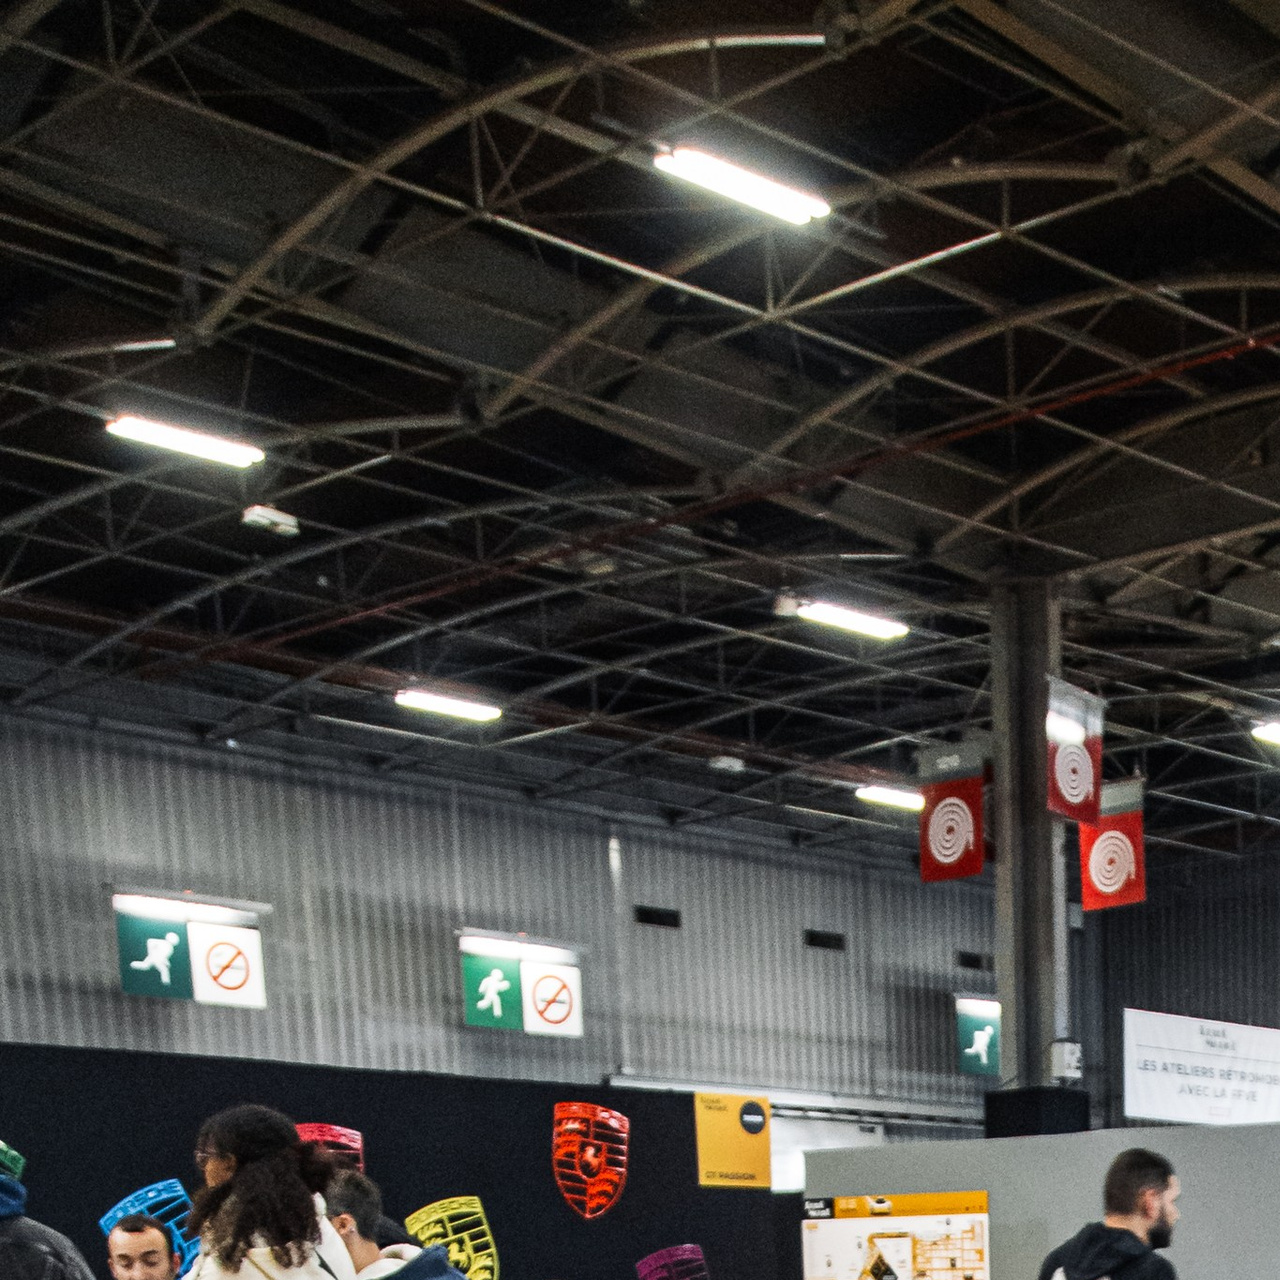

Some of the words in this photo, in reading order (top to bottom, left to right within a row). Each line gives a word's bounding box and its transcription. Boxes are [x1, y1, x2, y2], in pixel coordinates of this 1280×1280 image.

[1137, 1059, 1157, 1072] LES
[1161, 1062, 1215, 1079] ATELIERS
[1178, 1083, 1209, 1097] AVEC
[1214, 1087, 1228, 1098] LA
